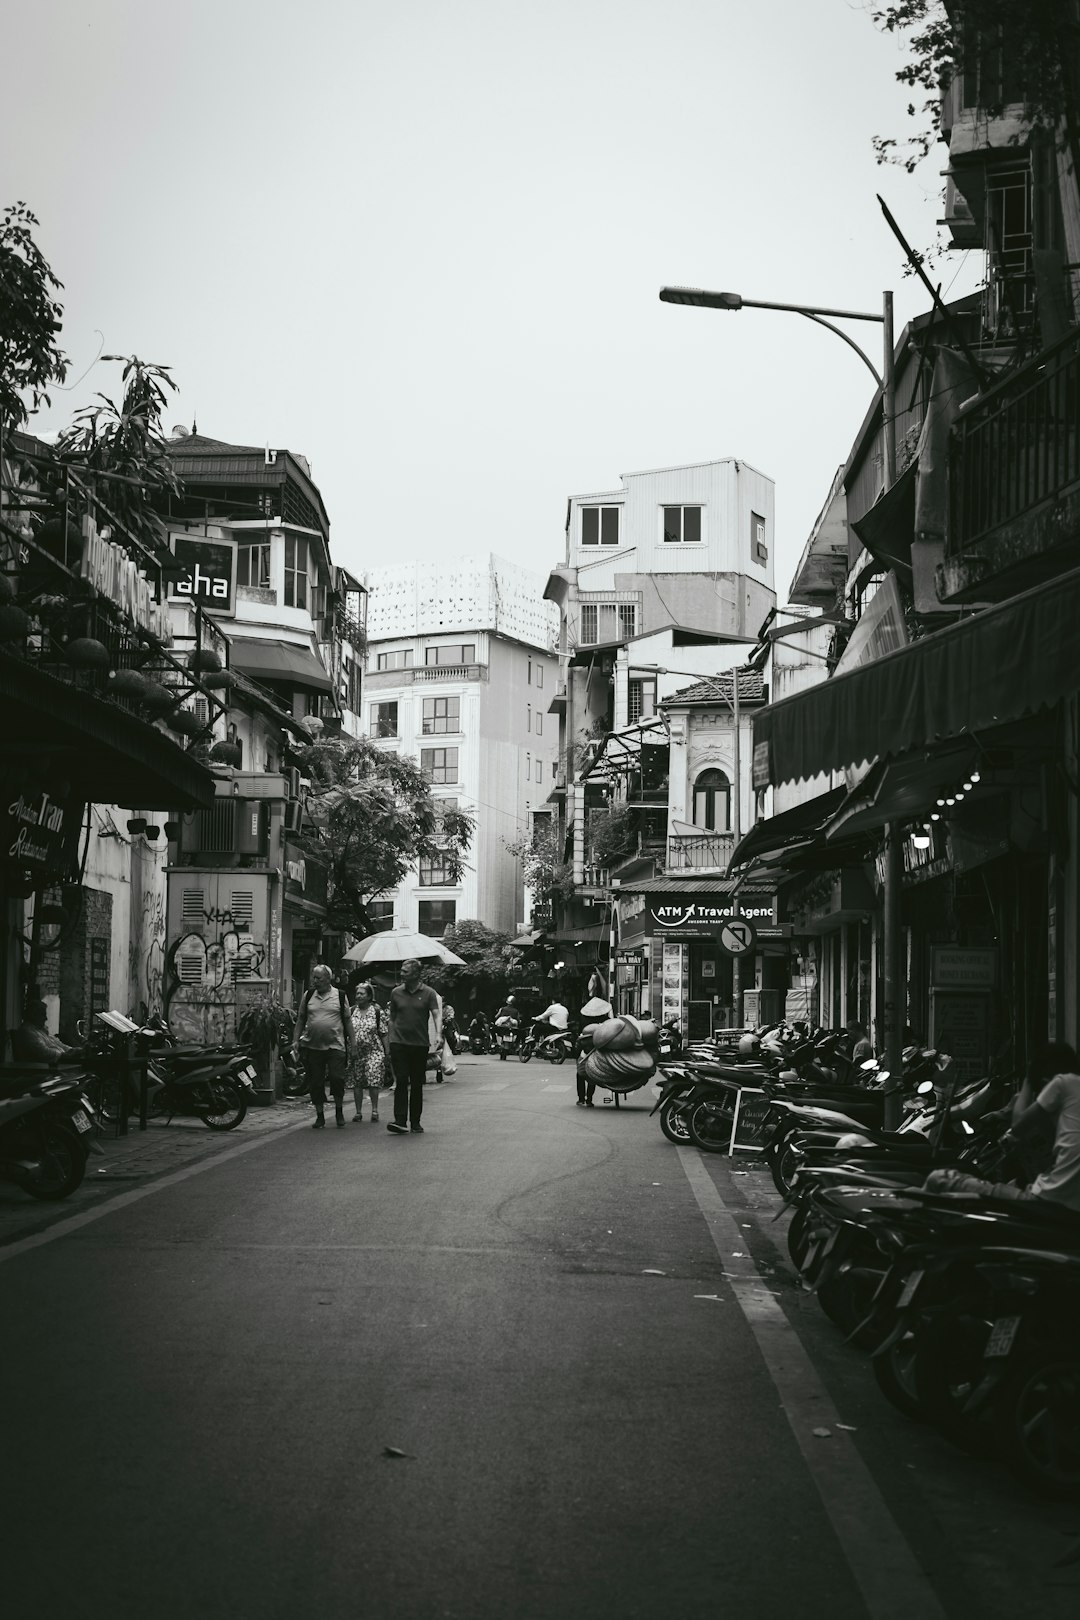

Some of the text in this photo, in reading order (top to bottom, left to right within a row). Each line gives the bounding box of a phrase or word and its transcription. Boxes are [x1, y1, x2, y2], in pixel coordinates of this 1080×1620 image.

[38, 792, 64, 833] Tran
[657, 906, 682, 917] ATM
[698, 906, 734, 917] Travel
